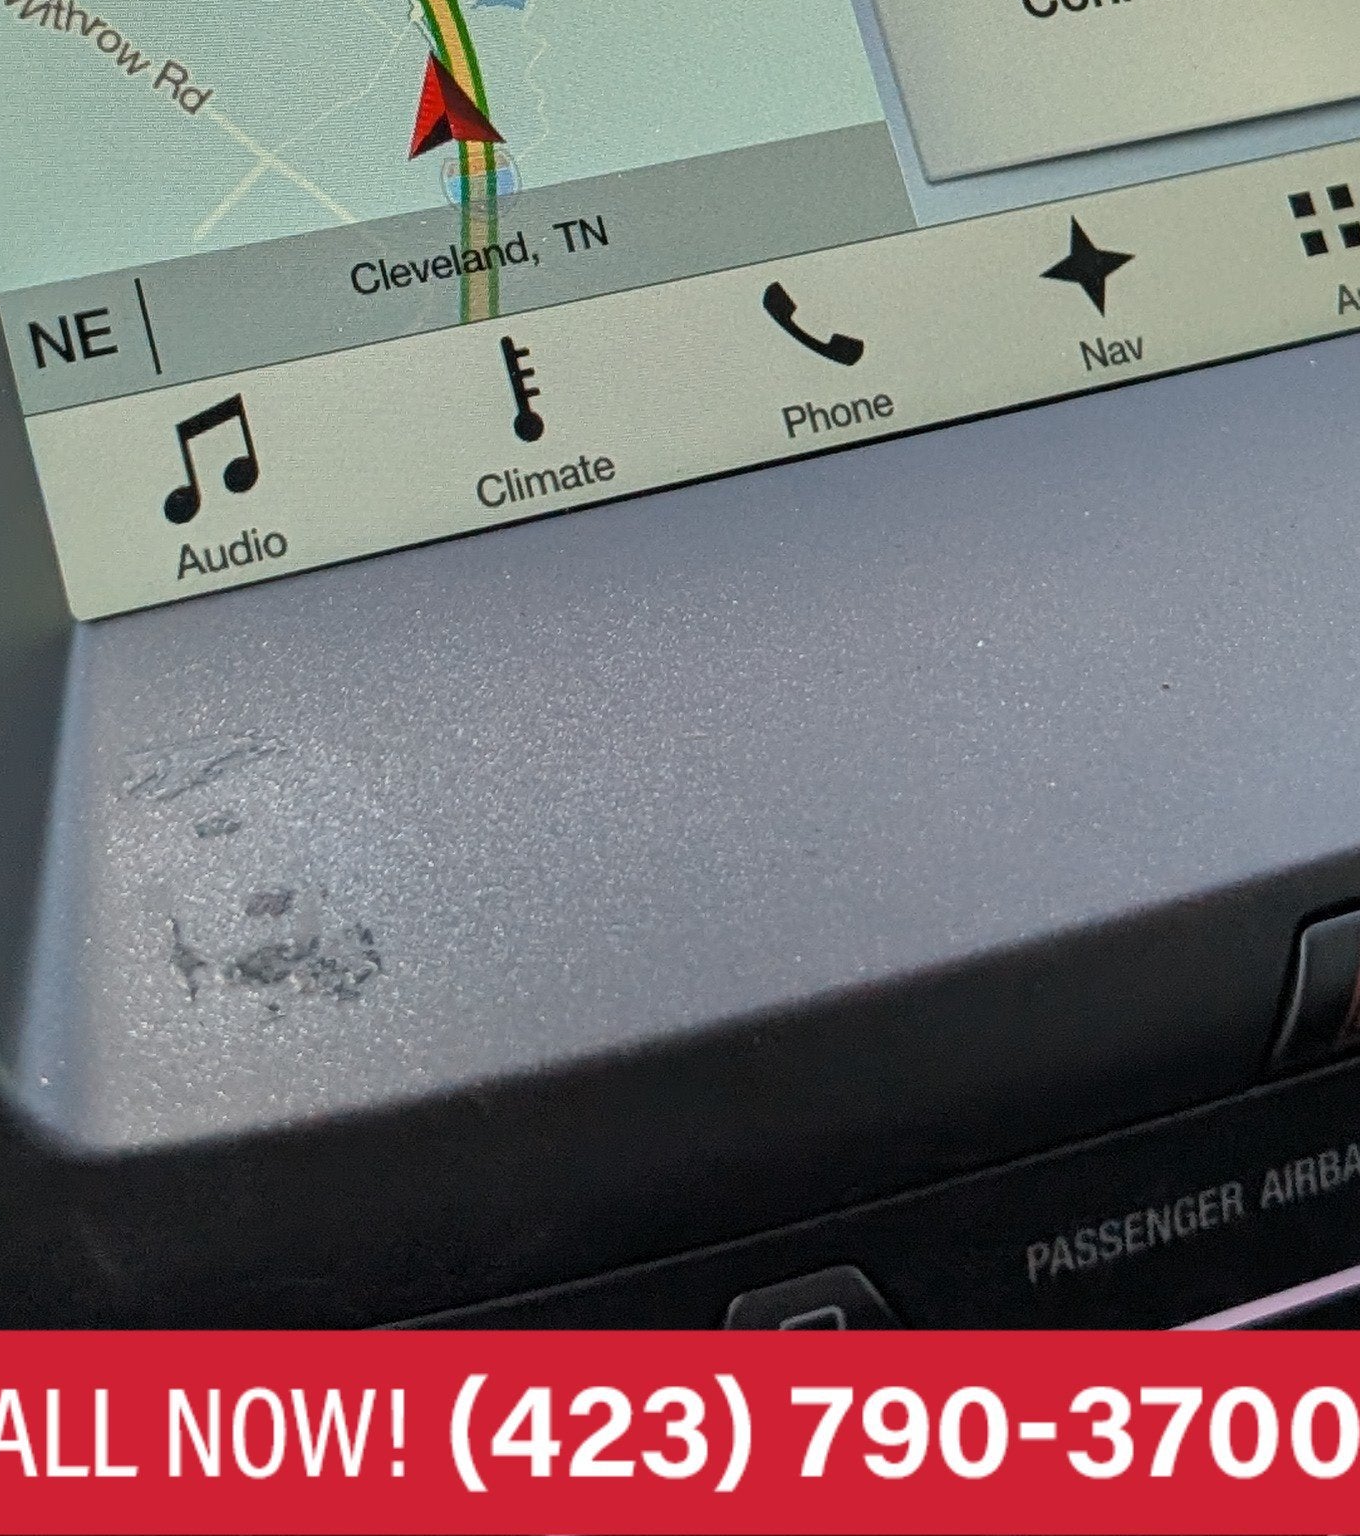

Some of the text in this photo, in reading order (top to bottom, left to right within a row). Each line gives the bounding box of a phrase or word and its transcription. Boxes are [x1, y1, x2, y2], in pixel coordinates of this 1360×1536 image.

[152, 59, 214, 115] Rd
[351, 217, 610, 297] Cleveland, TN
[27, 307, 119, 371] NE
[1079, 336, 1144, 372] Nav
[782, 388, 894, 440] Phone
[475, 452, 616, 511] Climate
[176, 526, 289, 580] Audio
[1026, 1181, 1244, 1284] PASSENGER
